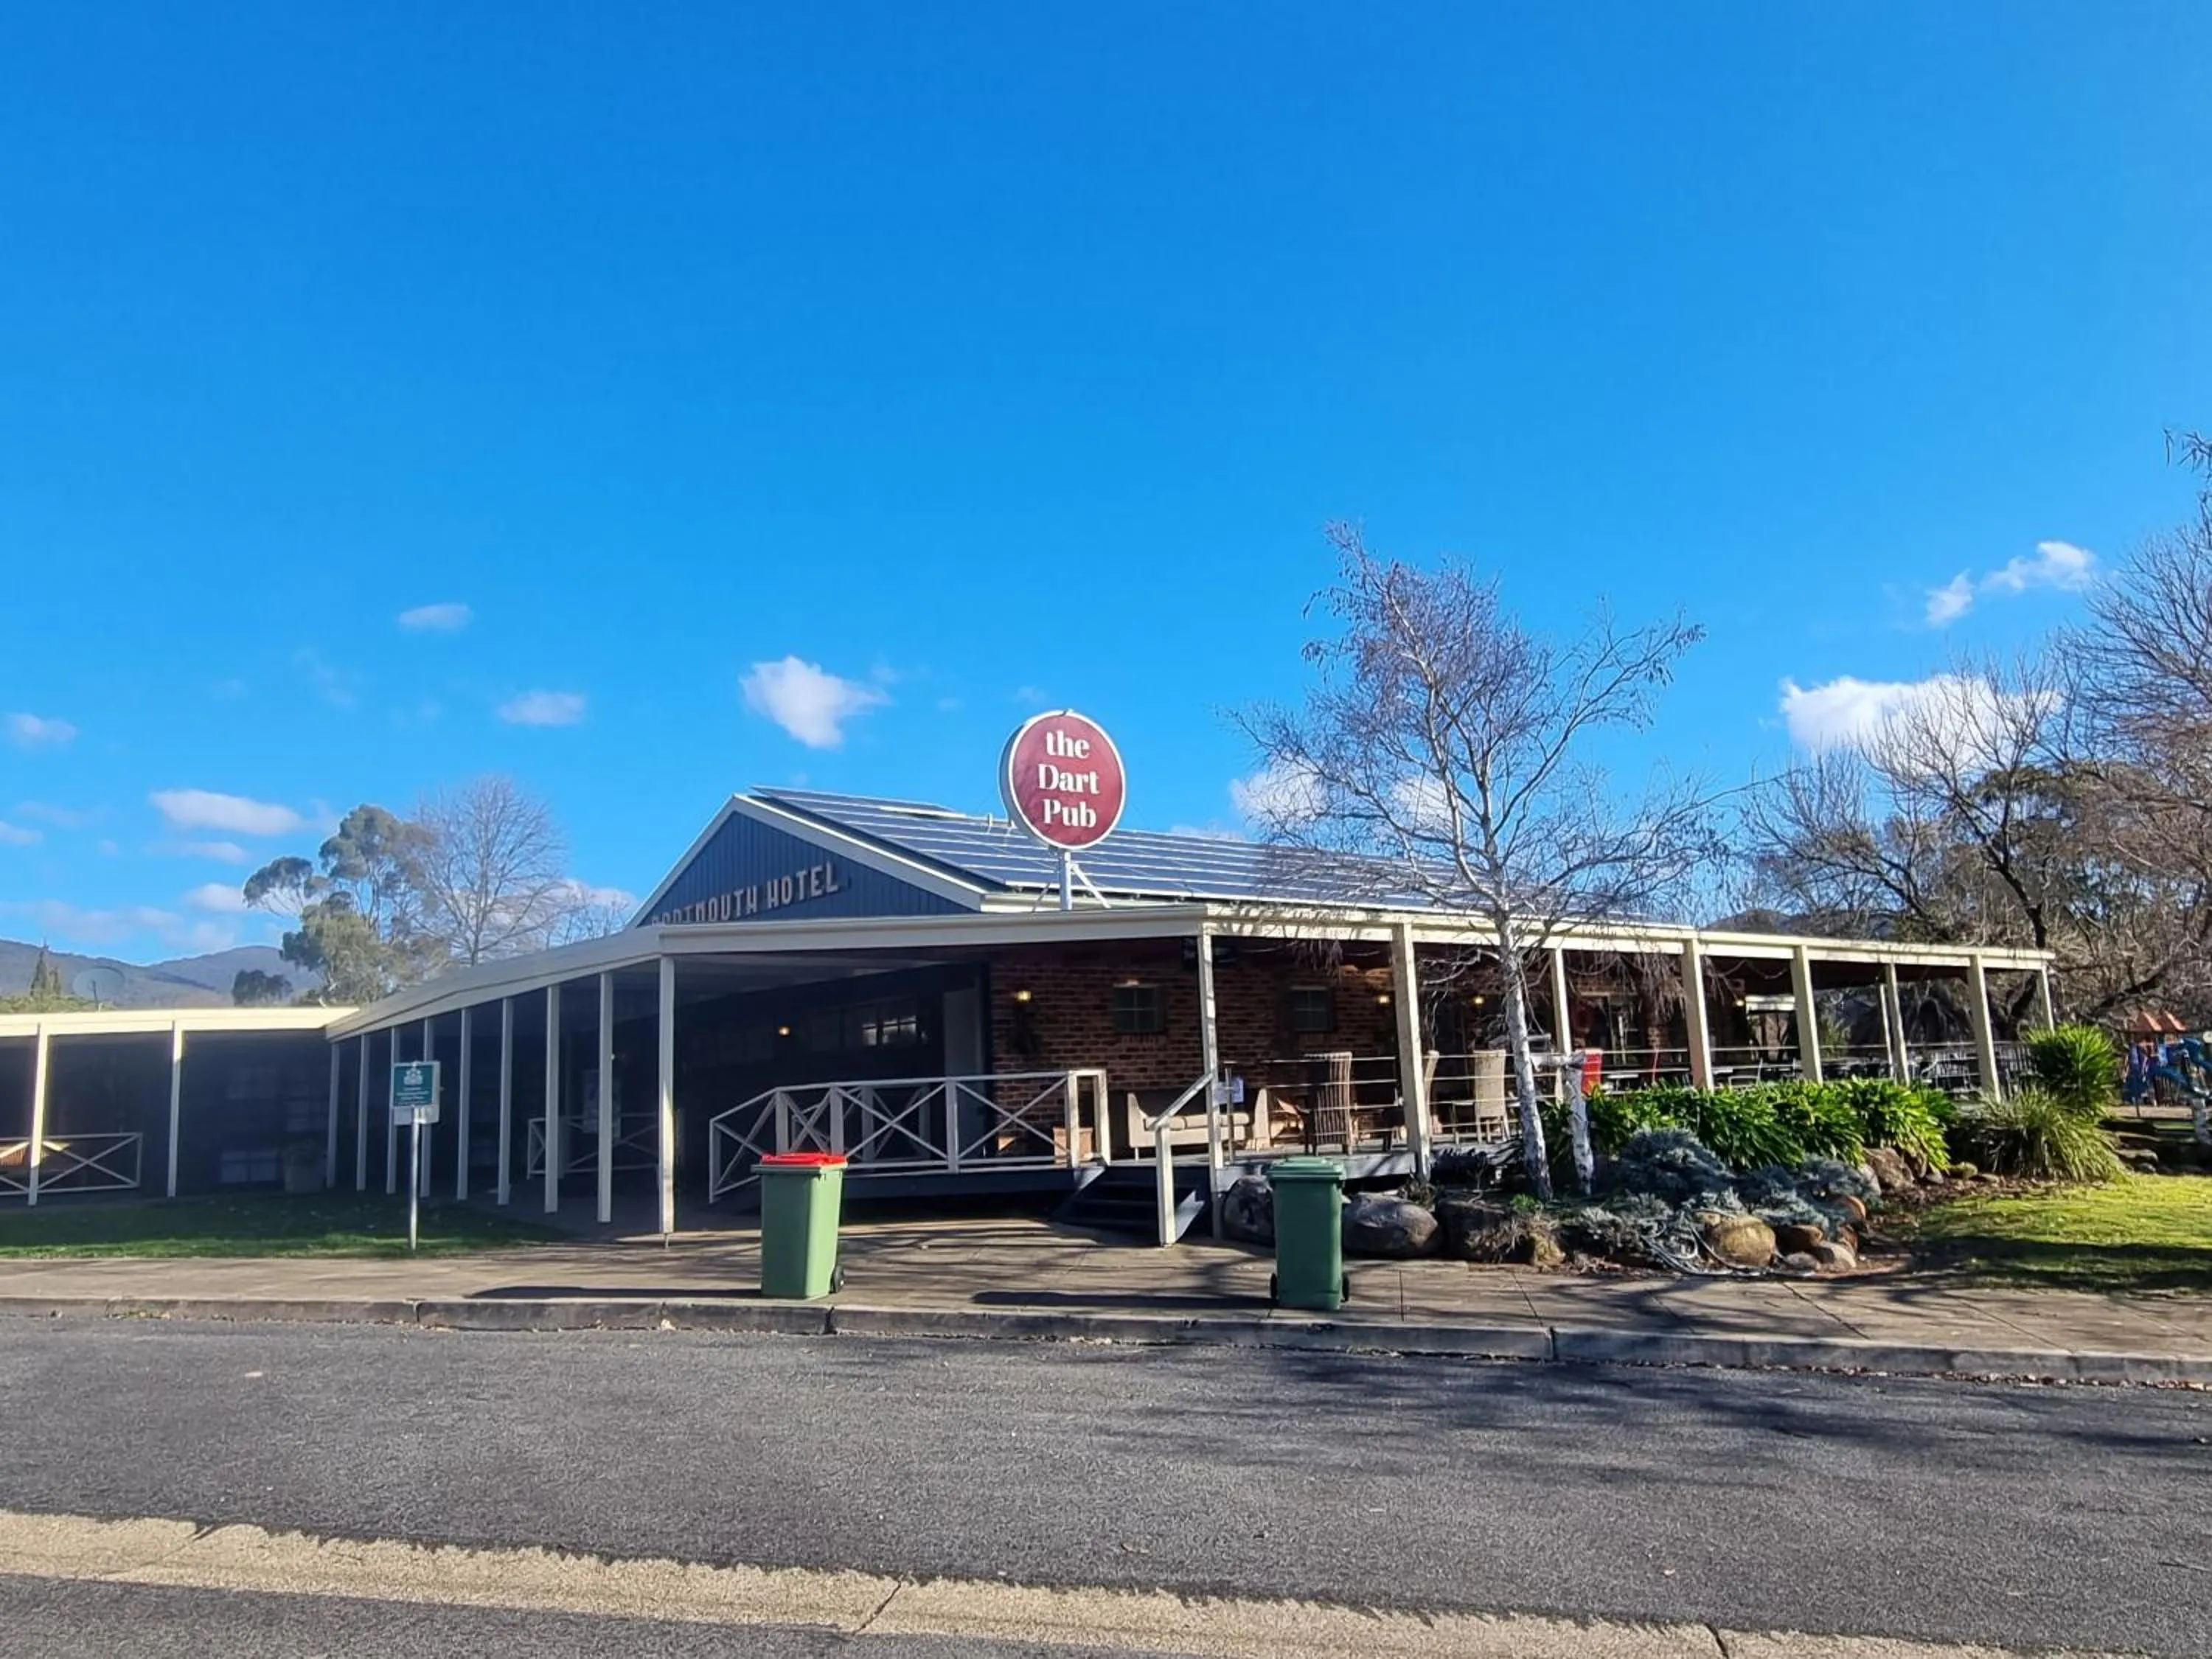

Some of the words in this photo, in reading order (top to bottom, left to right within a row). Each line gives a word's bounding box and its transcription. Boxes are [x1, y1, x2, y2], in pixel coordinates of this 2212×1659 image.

[1046, 730, 1091, 759] the
[1037, 763, 1101, 795] Dart
[1042, 799, 1097, 828] Pub
[767, 861, 838, 909] HOTEL
